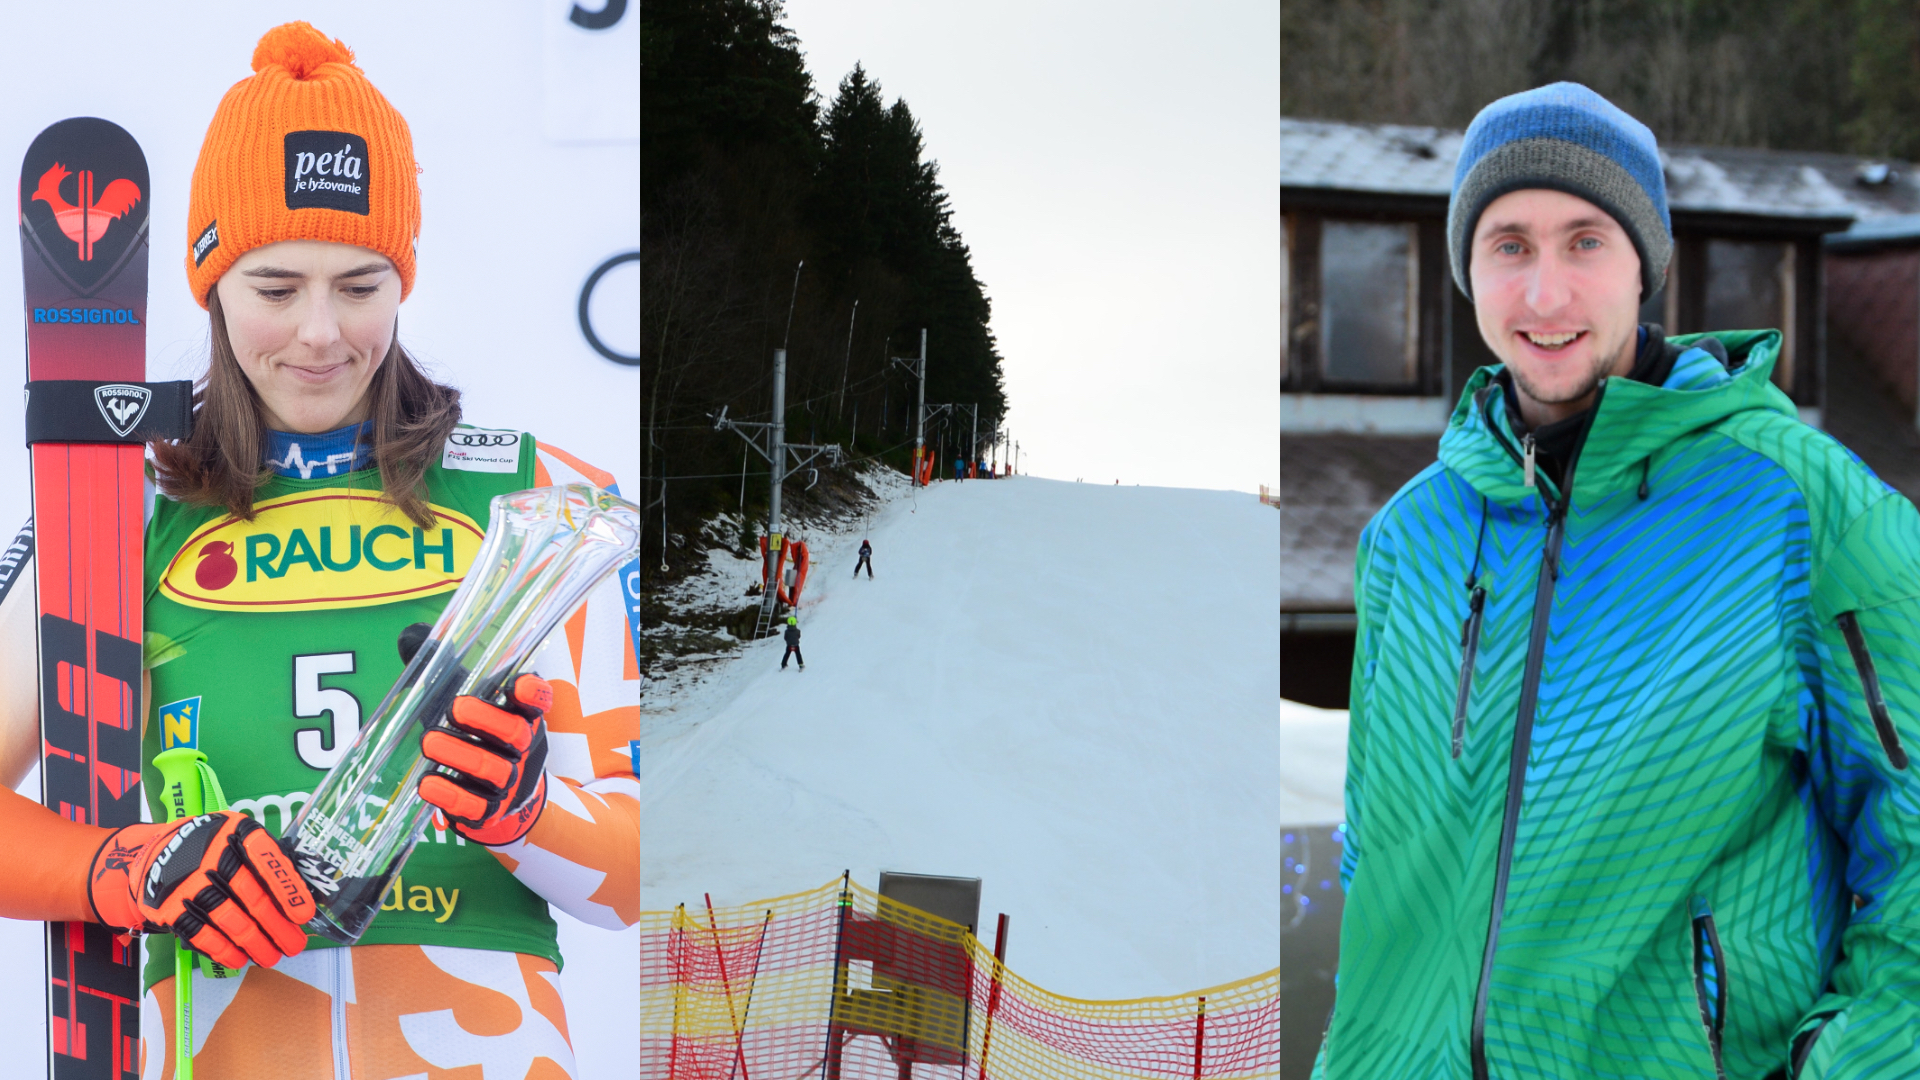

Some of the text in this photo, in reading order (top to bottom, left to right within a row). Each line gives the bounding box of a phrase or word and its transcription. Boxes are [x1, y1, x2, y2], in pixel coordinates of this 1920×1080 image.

[293, 177, 361, 194] je lyžovanie
[294, 143, 362, 179] peťa
[245, 524, 455, 583] RAUCH
[164, 712, 191, 750] N
[291, 650, 364, 772] 5
[146, 815, 213, 898] reusch
[297, 826, 361, 878] WELTCUP
[307, 807, 375, 863] SEMMERING
[260, 851, 306, 908] racing
[379, 875, 460, 923] day
